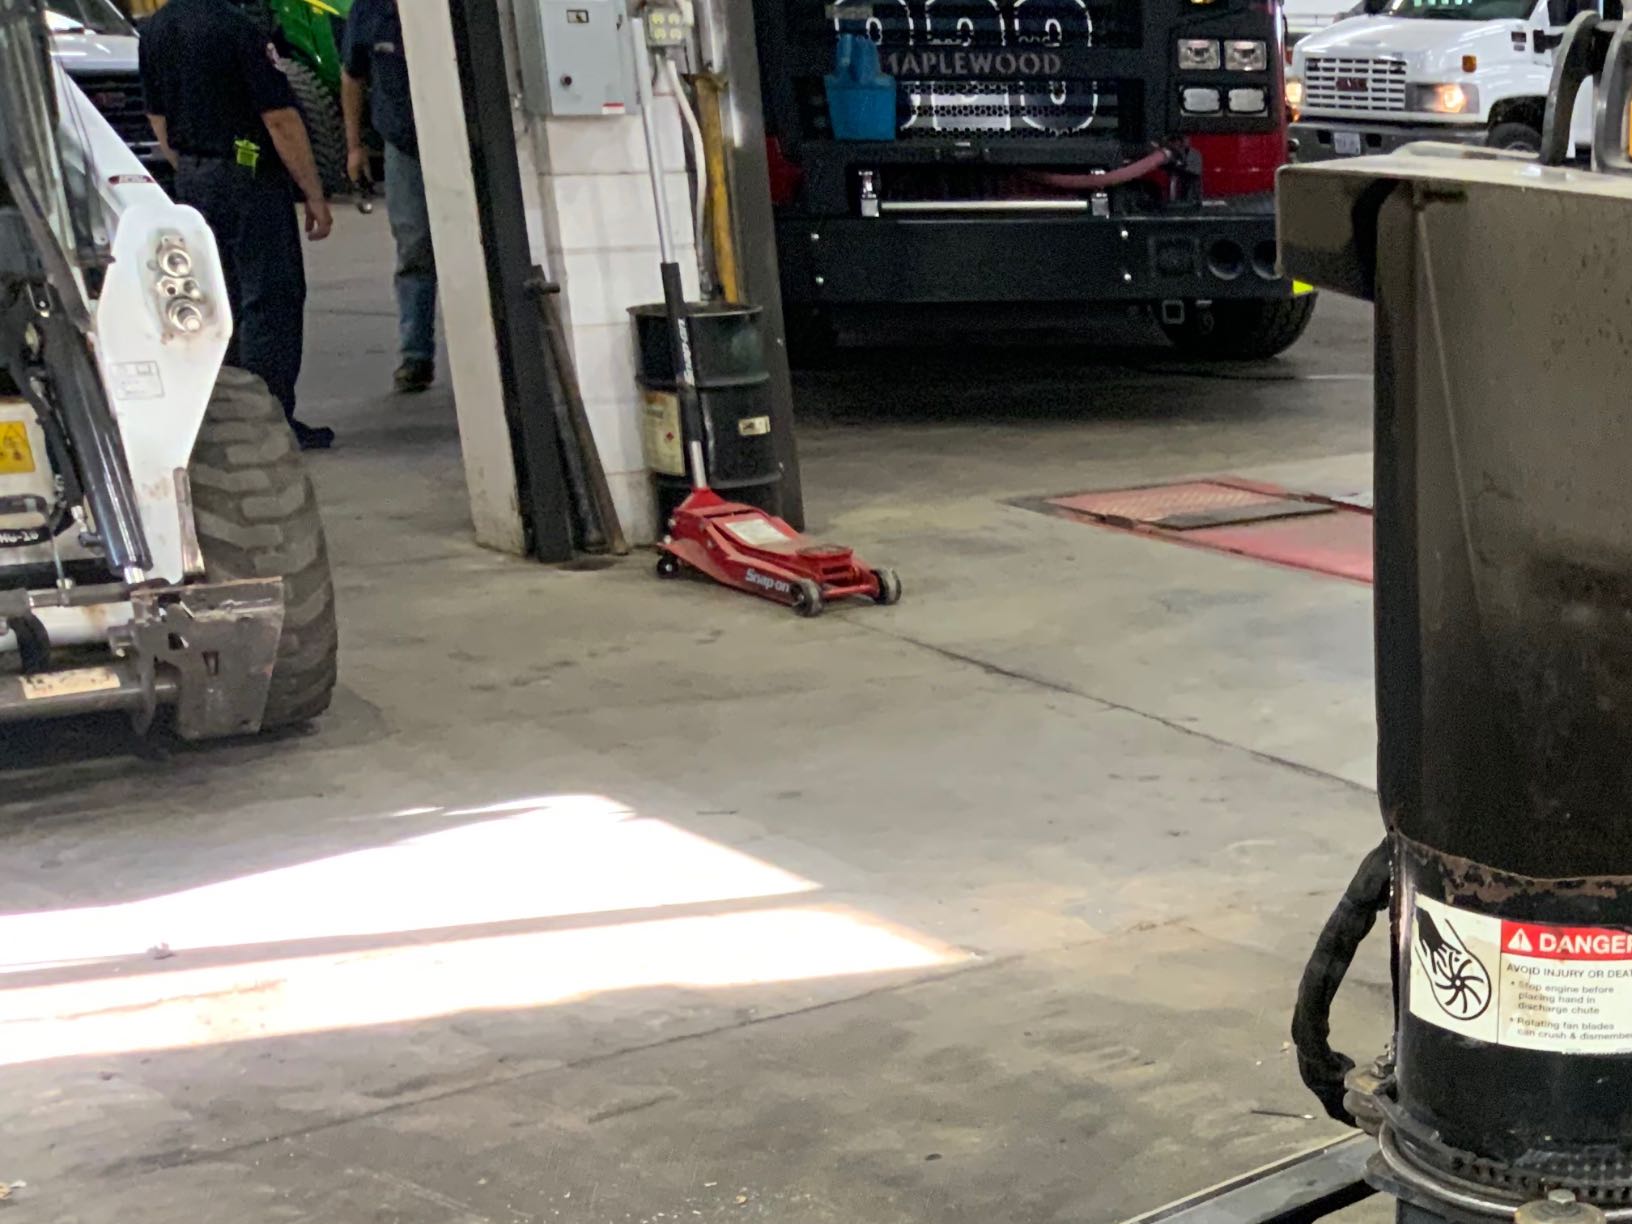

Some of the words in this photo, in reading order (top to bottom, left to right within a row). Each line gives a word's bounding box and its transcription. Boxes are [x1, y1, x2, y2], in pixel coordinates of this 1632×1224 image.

[745, 567, 790, 594] Snap-on
[1506, 963, 1541, 976] AVOID
[1544, 967, 1584, 979] INJURY
[1587, 969, 1605, 979] OR
[1545, 985, 1579, 994] engine
[1582, 985, 1615, 994] before
[1518, 991, 1556, 1004] placing
[1518, 1001, 1569, 1015] discharge
[1517, 1016, 1561, 1030] Rotating
[1581, 1022, 1615, 1031] blades
[1538, 1030, 1568, 1040] crush
